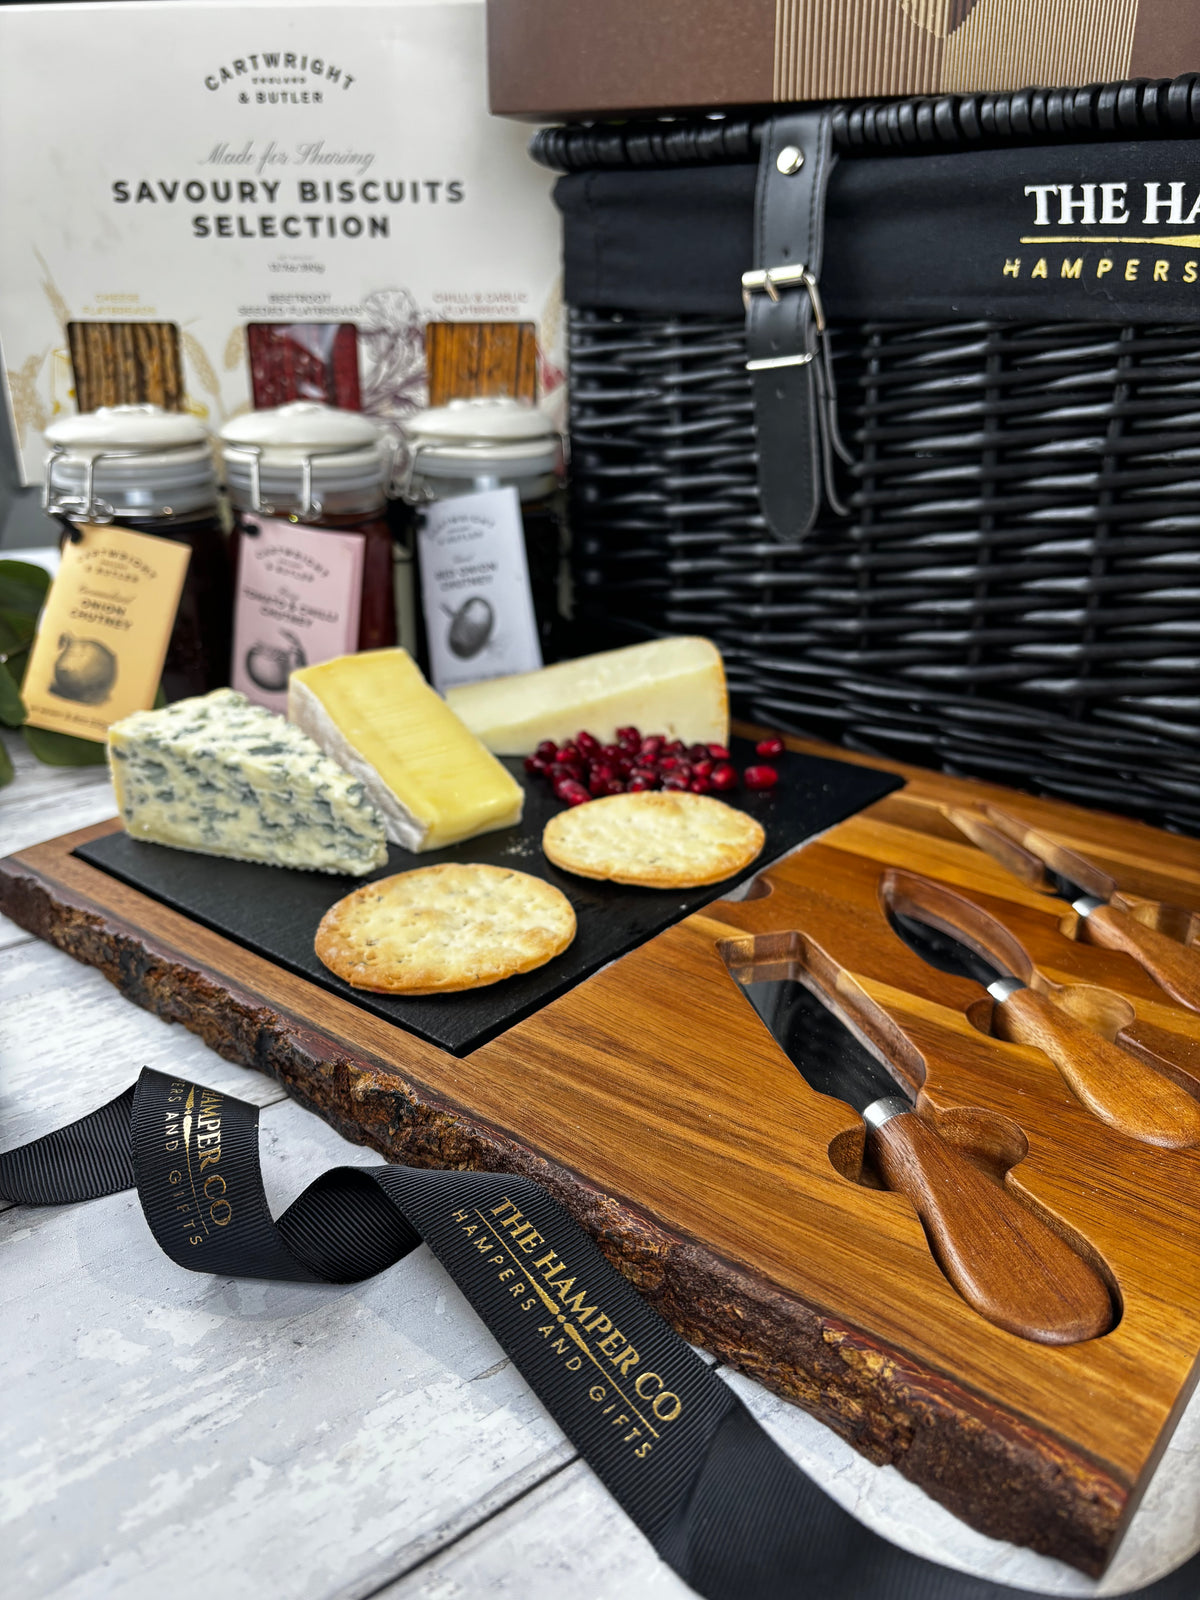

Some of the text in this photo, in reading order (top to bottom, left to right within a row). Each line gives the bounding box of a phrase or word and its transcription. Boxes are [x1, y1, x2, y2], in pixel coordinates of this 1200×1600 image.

[204, 53, 354, 91] CARTWRIGHT
[239, 92, 323, 103] & BUTLER
[199, 140, 376, 176] Made for Sharing
[112, 180, 466, 204] SAVOURY BISCUITS
[1024, 182, 1130, 225] THE
[192, 215, 391, 239] SELECTION
[1003, 257, 1198, 283] HAMPERS
[165, 1080, 202, 1245] ERS AND GIFTS
[197, 1089, 232, 1226] HAMPER CO
[491, 1196, 681, 1421] THE HAMPER CO
[452, 1208, 651, 1458] HAMPERS AND GIFTS
